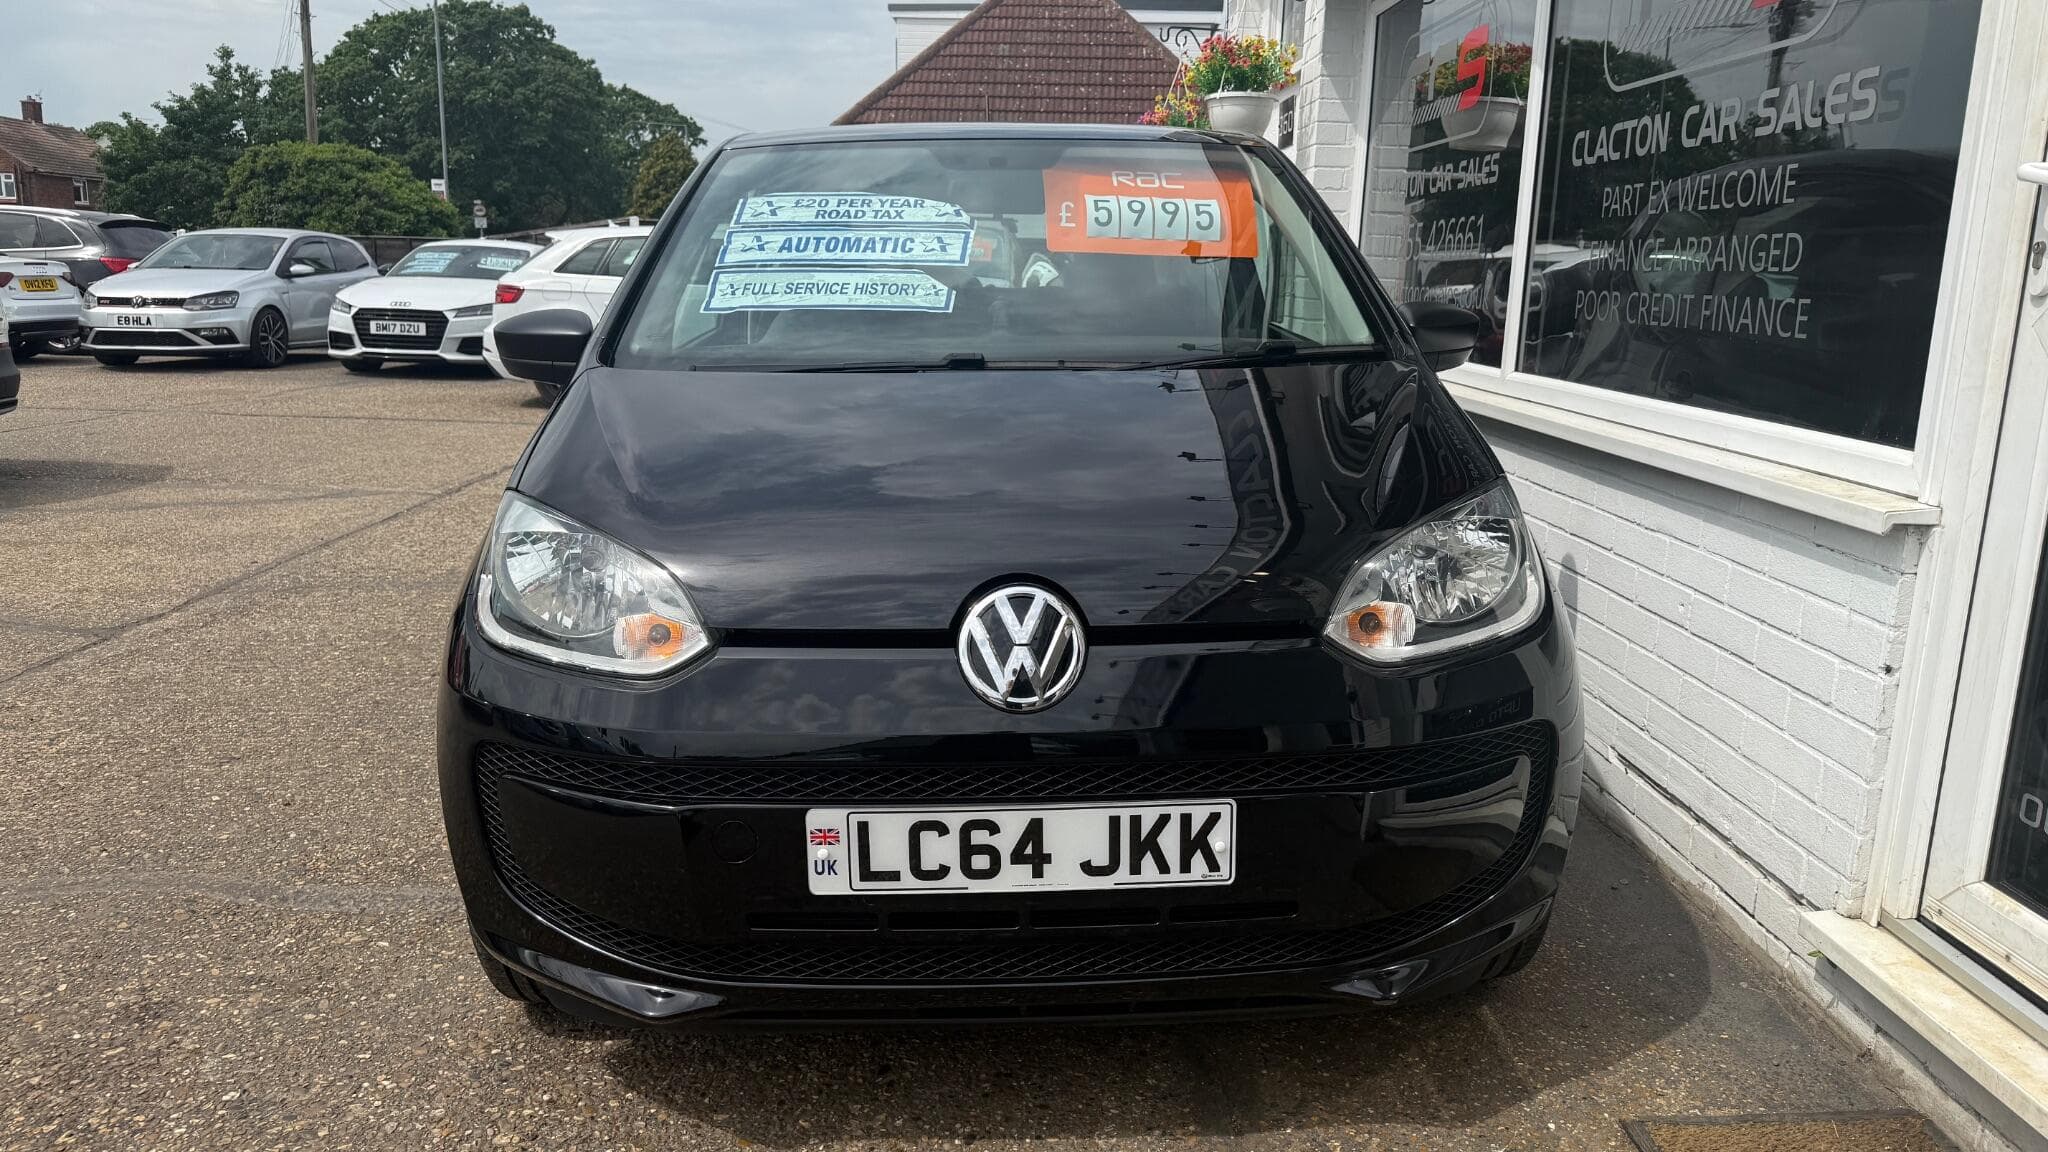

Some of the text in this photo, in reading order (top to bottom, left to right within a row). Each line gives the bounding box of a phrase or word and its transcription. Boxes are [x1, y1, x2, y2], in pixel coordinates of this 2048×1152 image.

[1571, 66, 1881, 167] CLACTON CAR SALES
[1429, 163, 1453, 194] CAR
[1457, 152, 1500, 190] SALES
[793, 198, 926, 210] £20 PER YEAR
[1601, 163, 1799, 219] PART EX WELCOME
[814, 209, 905, 220] ROAD TAX
[777, 236, 915, 254] AUTOMATIC
[1426, 214, 1485, 255] 426661
[1588, 232, 1803, 273] FINANCE ARRANGED
[741, 282, 920, 296] FULL SERVICE HISTORY
[132, 316, 152, 326] HLA
[375, 322, 420, 334] BM17 DZU
[1574, 290, 1811, 339] POOR CREDIT FINANCE
[857, 811, 1222, 882] LC64 JKK
[814, 859, 838, 876] UK
